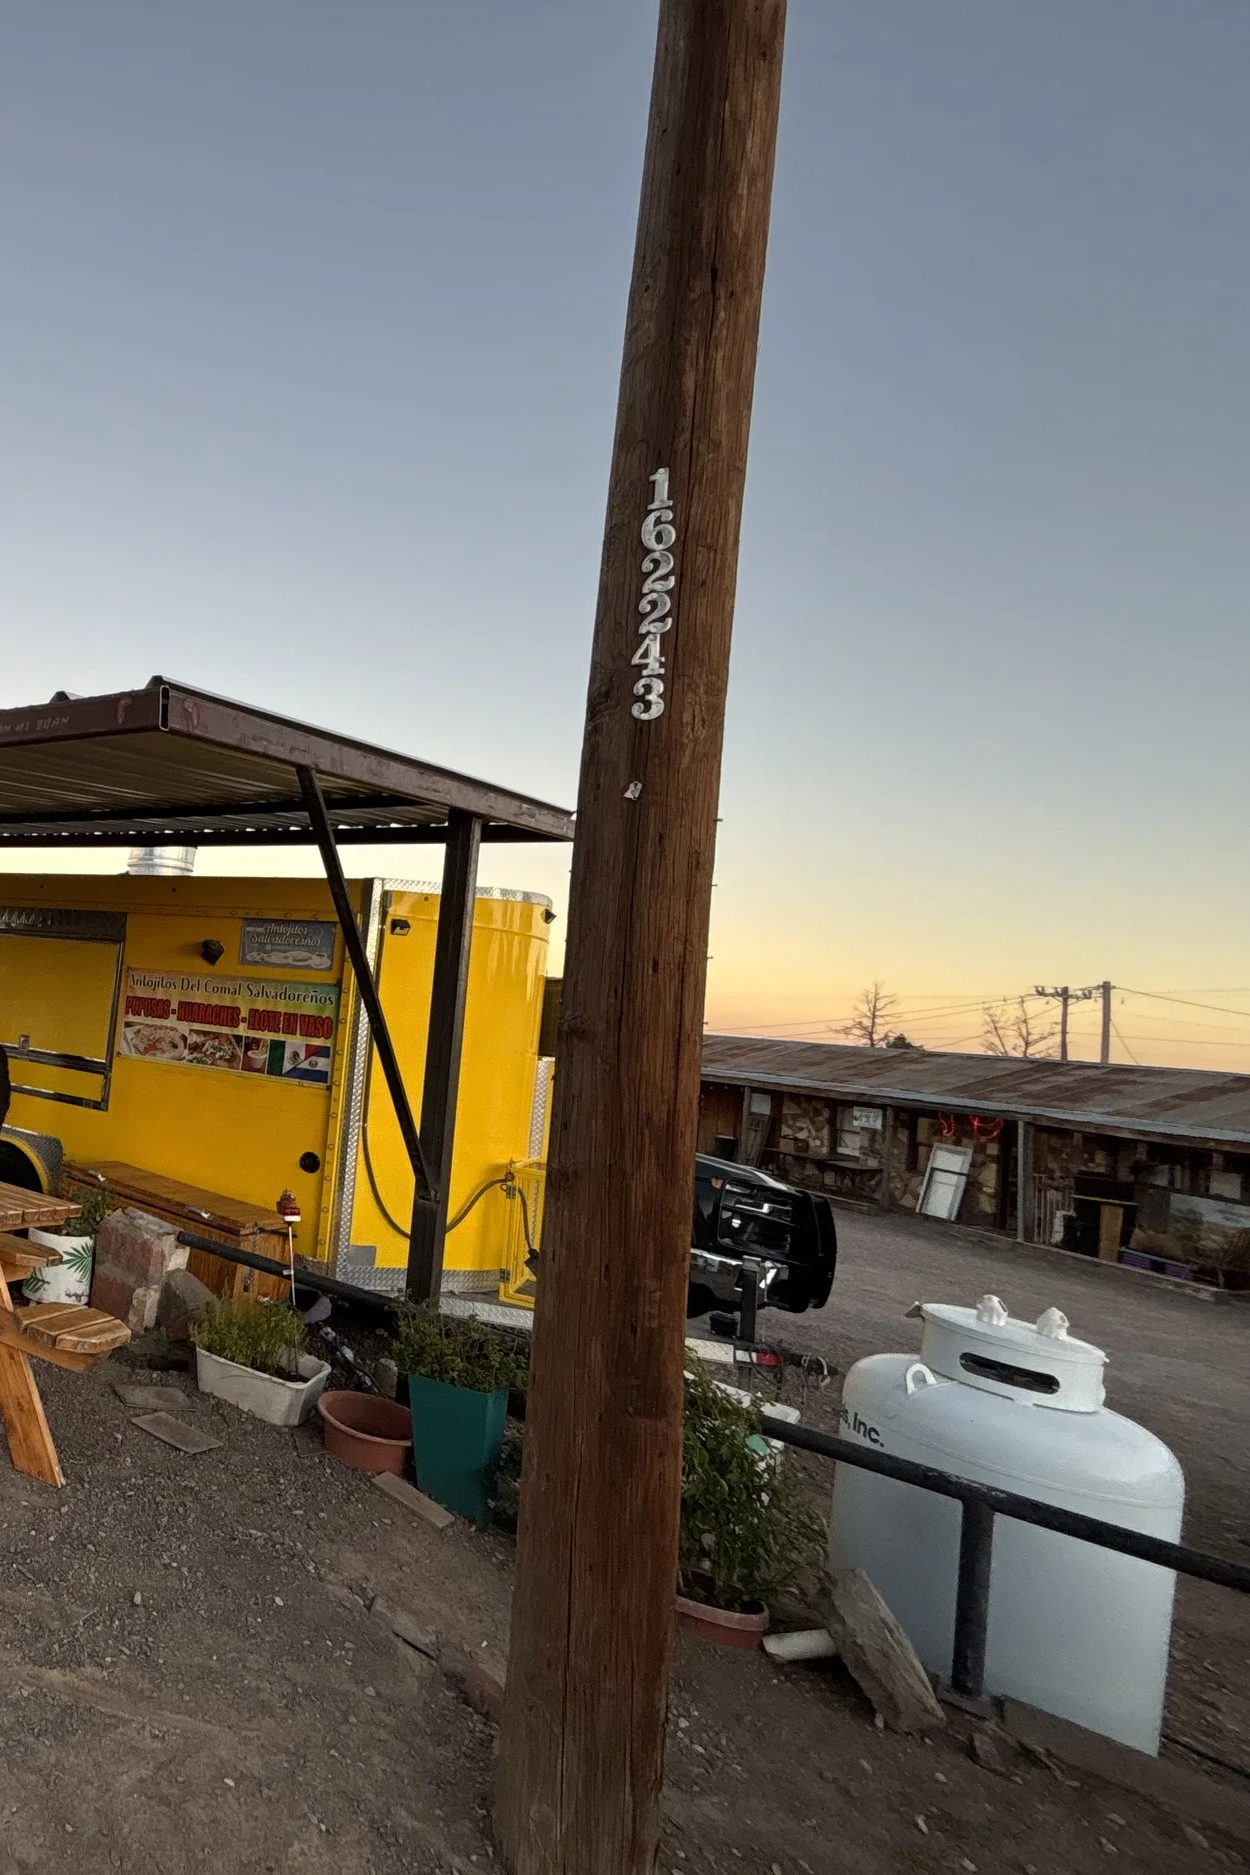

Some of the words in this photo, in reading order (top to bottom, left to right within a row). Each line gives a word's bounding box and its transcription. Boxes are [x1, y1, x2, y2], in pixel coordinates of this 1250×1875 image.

[631, 467, 676, 720] 162243
[266, 923, 308, 936] Antojitos
[181, 977, 200, 992] Del
[204, 979, 242, 996] Comal
[246, 983, 334, 1006] Salvadoreños
[124, 995, 171, 1020] PUPUSAS
[177, 1001, 241, 1028] HUARACHES
[247, 1008, 282, 1033] ELOTE
[282, 1012, 299, 1035] EN
[299, 1013, 333, 1040] VASO
[853, 1411, 885, 1448] Inc.
